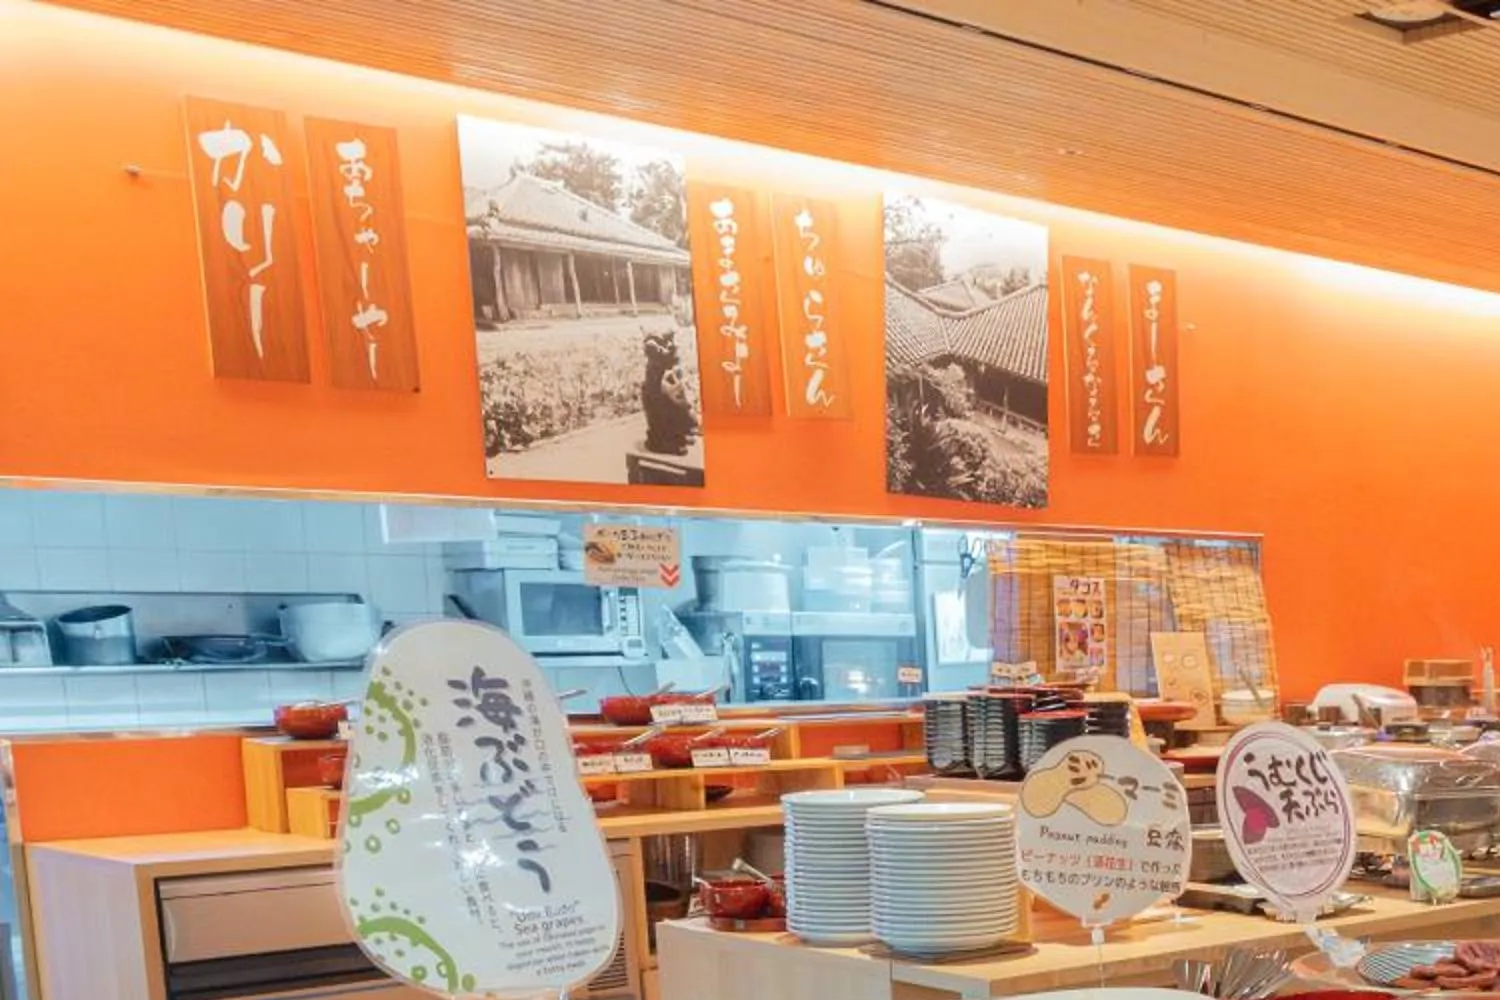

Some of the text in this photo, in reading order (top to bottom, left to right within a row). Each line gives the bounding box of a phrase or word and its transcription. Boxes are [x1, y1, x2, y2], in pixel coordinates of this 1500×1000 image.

[198, 121, 283, 360] かりー
[794, 209, 835, 407] ちゅらさん
[447, 665, 551, 894] 海ぶどう
[1243, 749, 1328, 791] うむくじ
[1280, 788, 1340, 824] 天ぷら
